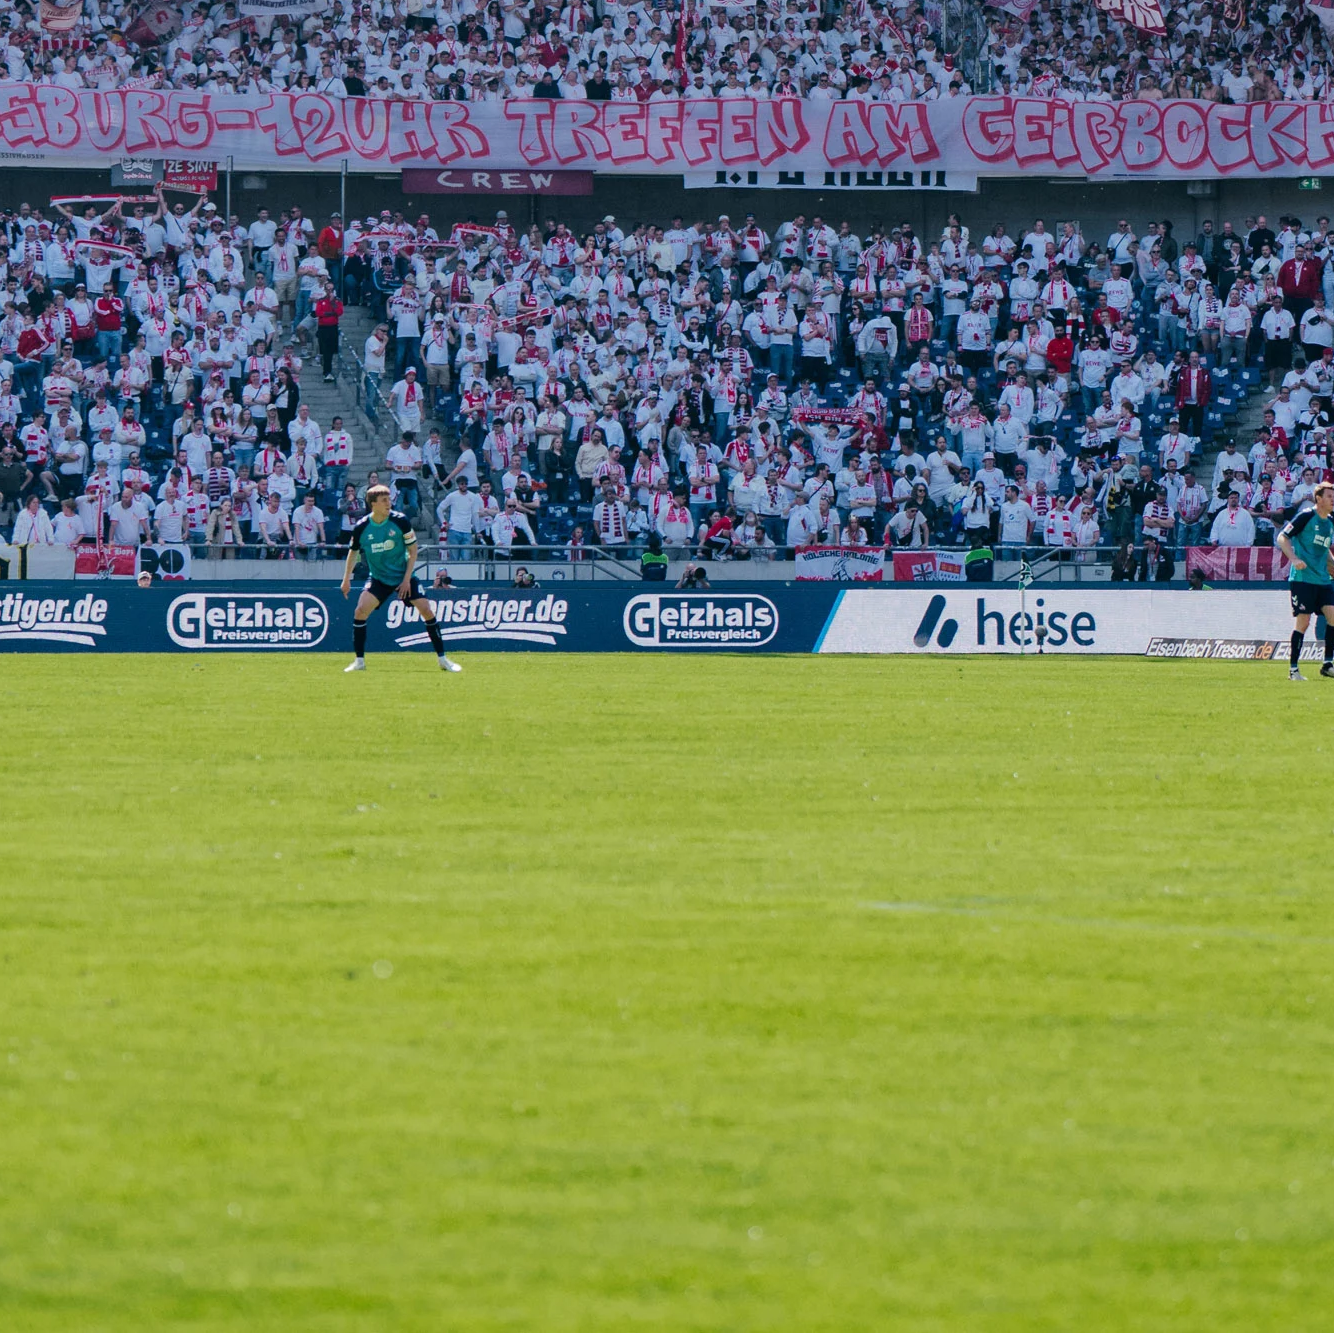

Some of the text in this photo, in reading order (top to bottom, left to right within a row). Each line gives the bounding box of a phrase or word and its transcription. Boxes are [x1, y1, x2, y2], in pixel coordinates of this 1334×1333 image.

[505, 98, 811, 167] TREFFEN
[823, 98, 941, 168] AM
[437, 171, 554, 190] CREW
[803, 549, 841, 562] KÖLSCHE
[175, 598, 323, 637] Geizhals
[386, 593, 566, 629] gunstiger.de
[629, 600, 772, 637] Geizhals
[977, 597, 1096, 646] heise
[212, 629, 312, 643] Preisvergleich
[666, 628, 761, 642] Preisvergleich
[1147, 638, 1273, 659] Eisenbach Tresore.de
